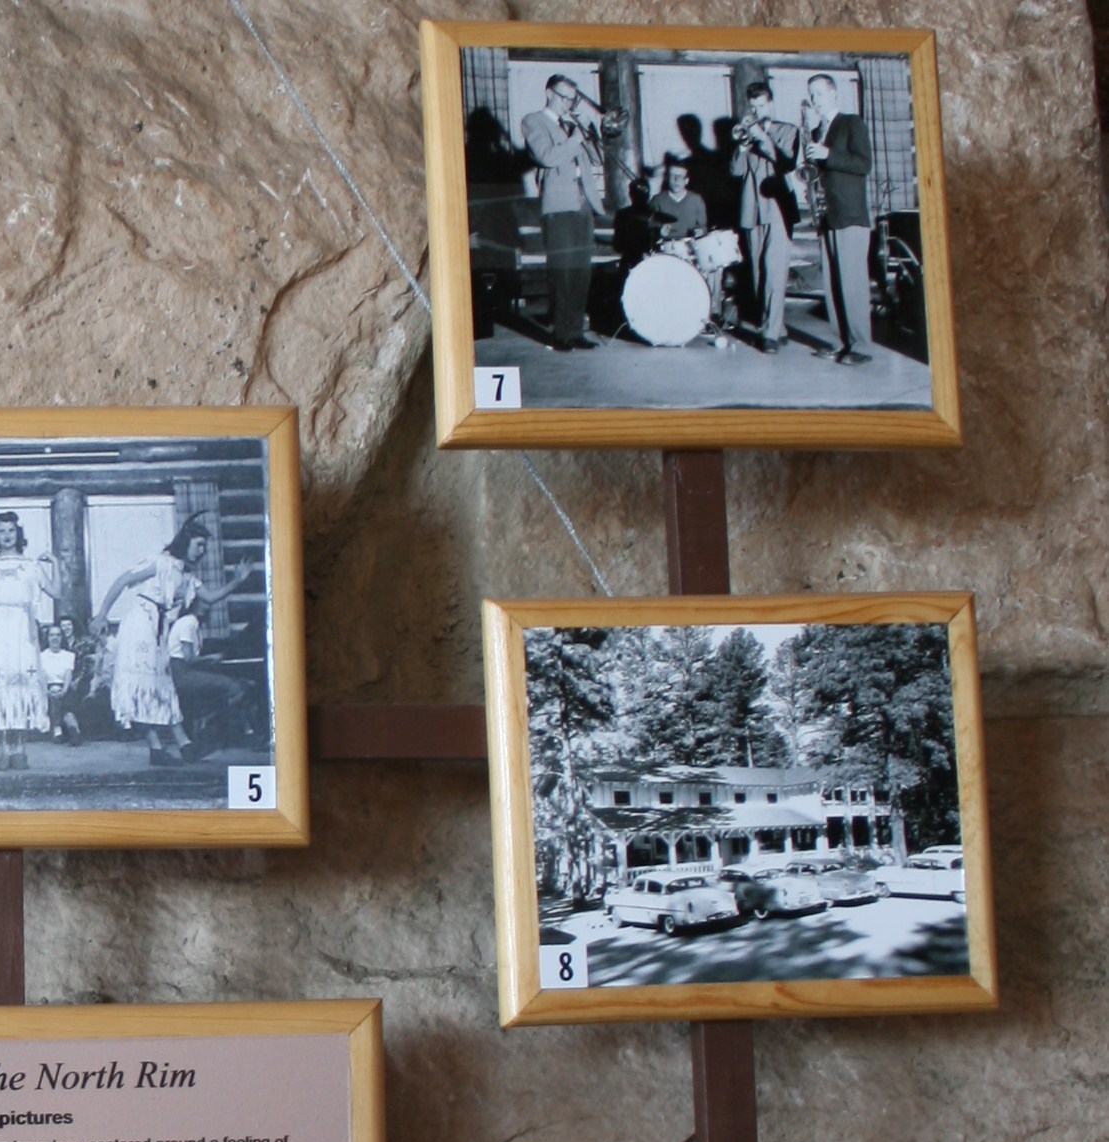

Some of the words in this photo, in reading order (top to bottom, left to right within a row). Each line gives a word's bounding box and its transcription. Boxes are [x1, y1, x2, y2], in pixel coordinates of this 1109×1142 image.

[492, 374, 505, 402] 7
[248, 773, 262, 803] 5
[559, 952, 574, 982] 8
[34, 1061, 125, 1090] North
[134, 1061, 196, 1089] Rim
[0, 1111, 74, 1130] pictures
